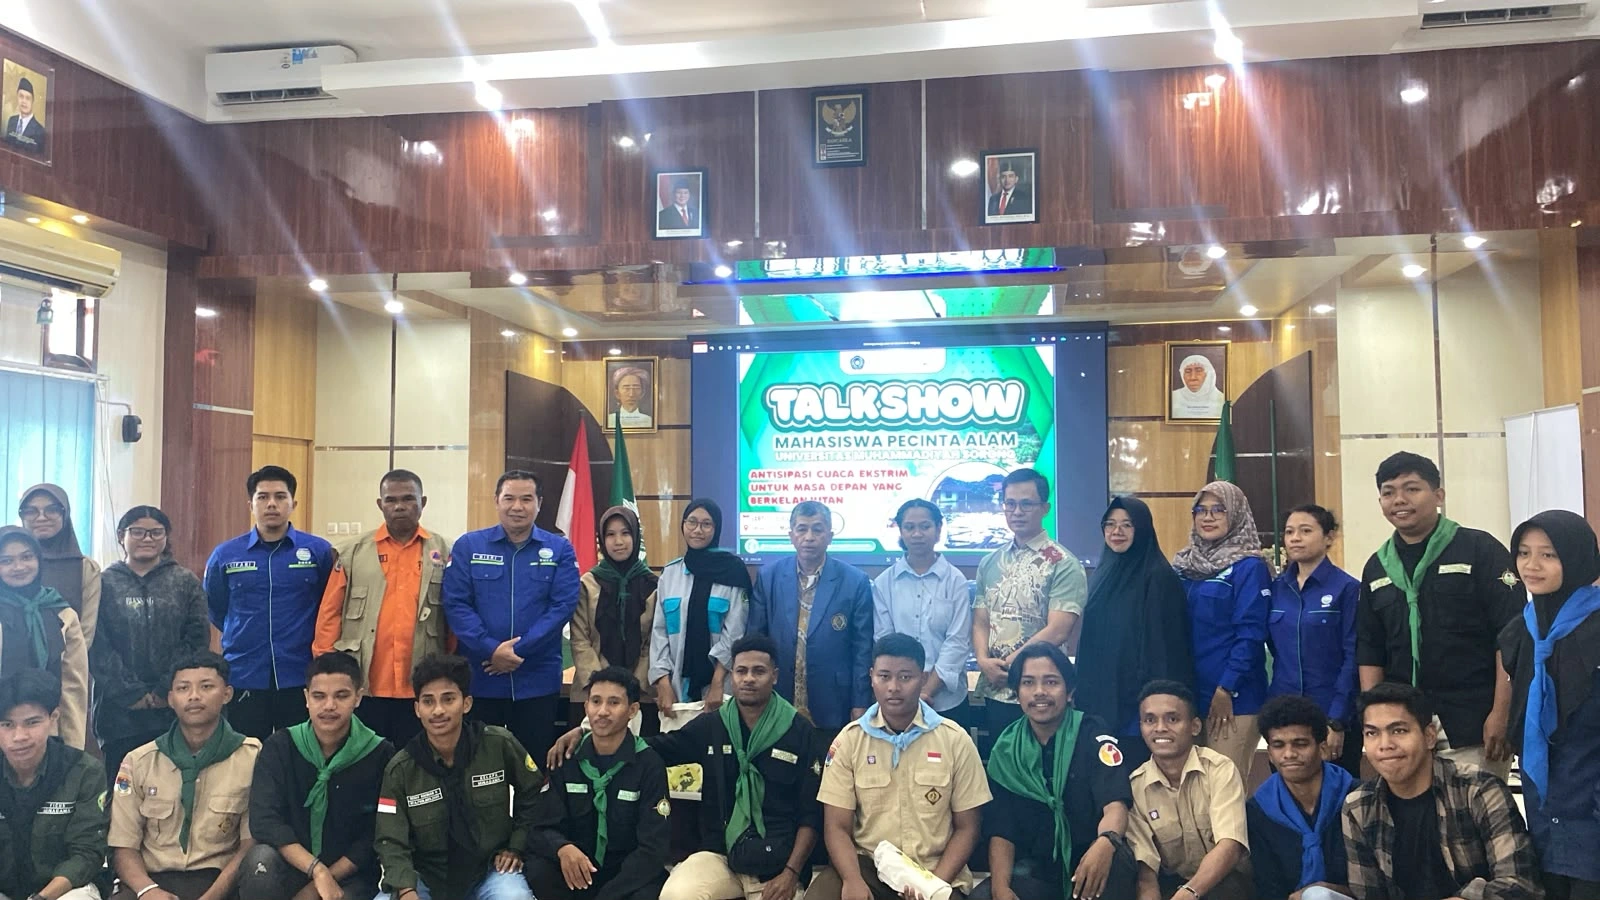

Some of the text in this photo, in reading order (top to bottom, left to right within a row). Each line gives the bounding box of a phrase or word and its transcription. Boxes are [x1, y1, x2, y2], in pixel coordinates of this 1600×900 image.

[768, 383, 1022, 421] TALKSHOW
[775, 433, 1016, 448] MAHASISWA PECINTA ALAM
[750, 469, 908, 479] ANTISIPASI CUACA EKSTRIM
[750, 482, 903, 492] UNTUK MASA DEPAN YANG
[750, 496, 844, 505] BERKELANTAN
